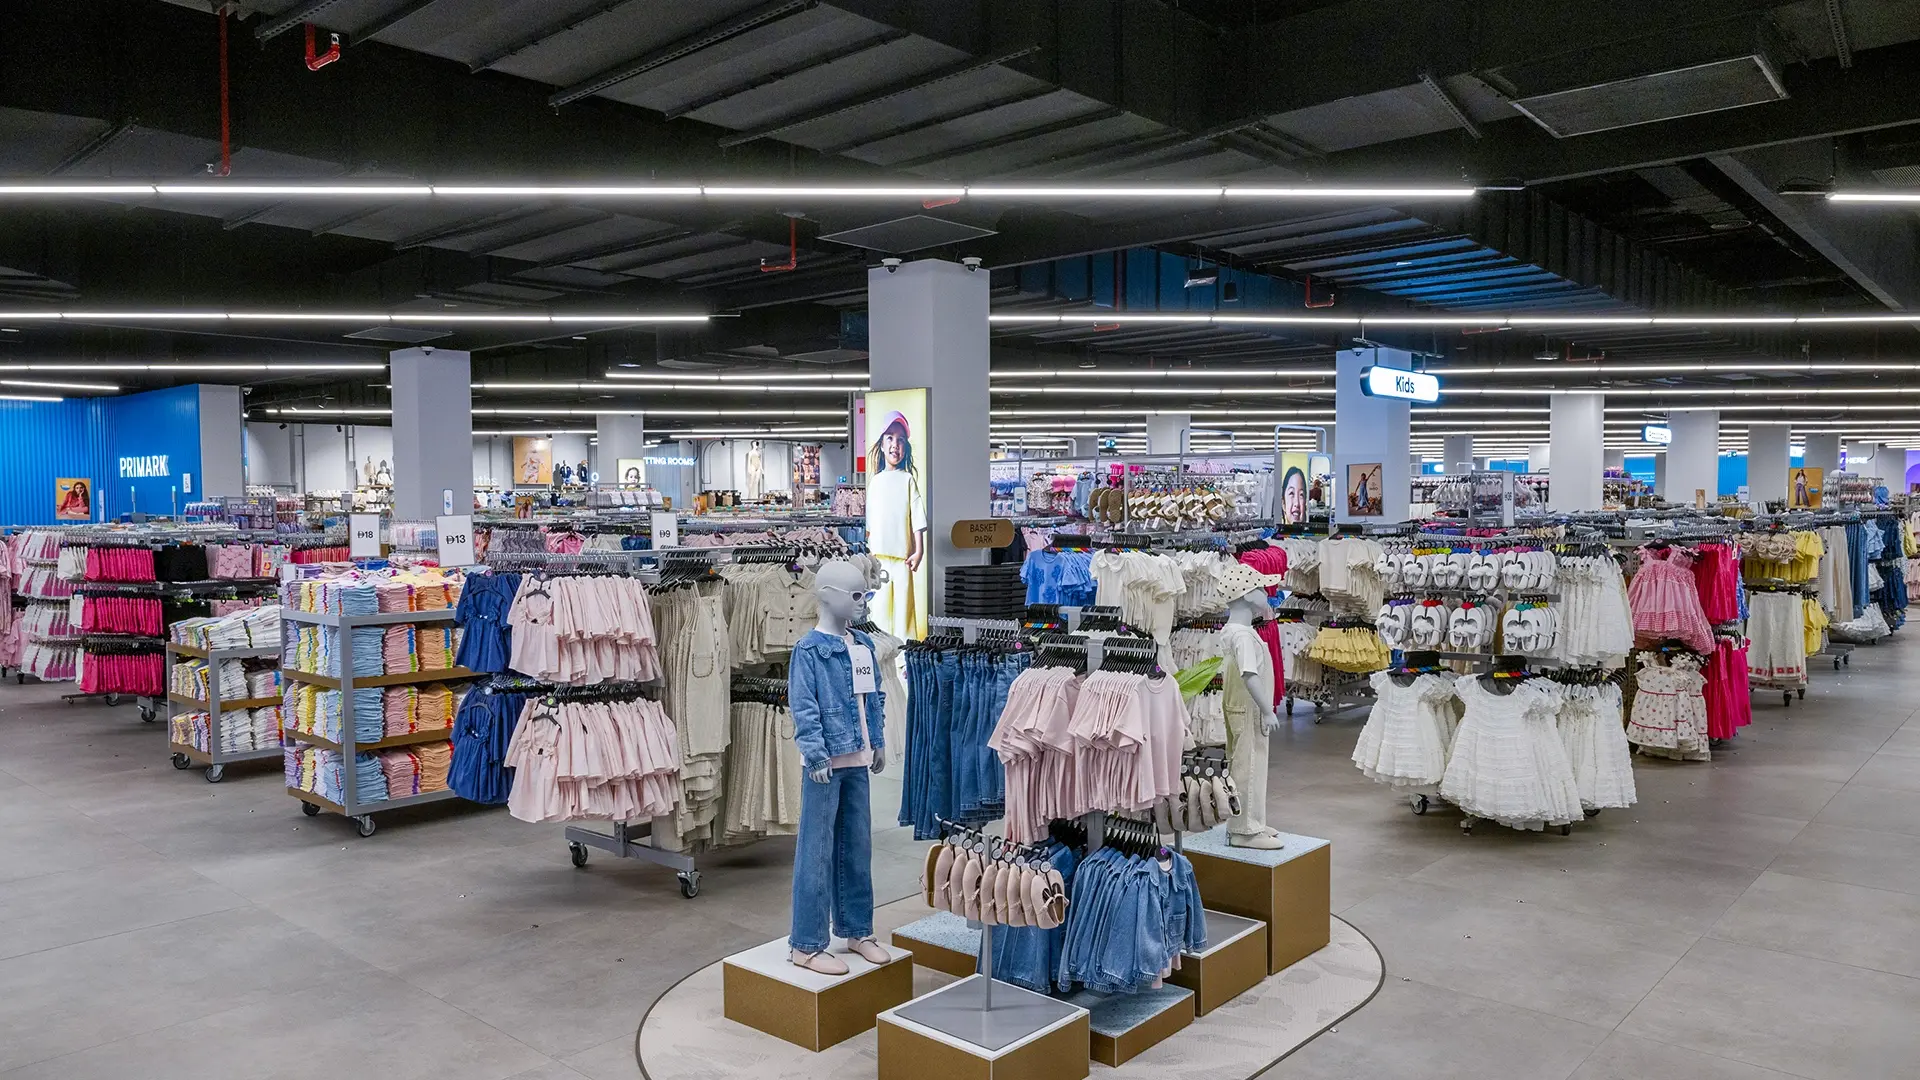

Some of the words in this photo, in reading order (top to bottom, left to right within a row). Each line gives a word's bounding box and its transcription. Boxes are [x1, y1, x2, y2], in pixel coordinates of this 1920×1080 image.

[1395, 376, 1415, 394] Kids
[119, 455, 168, 478] PRIMARK
[667, 457, 694, 466] ROOMS
[969, 523, 998, 533] BASKET
[973, 535, 993, 544] PARK
